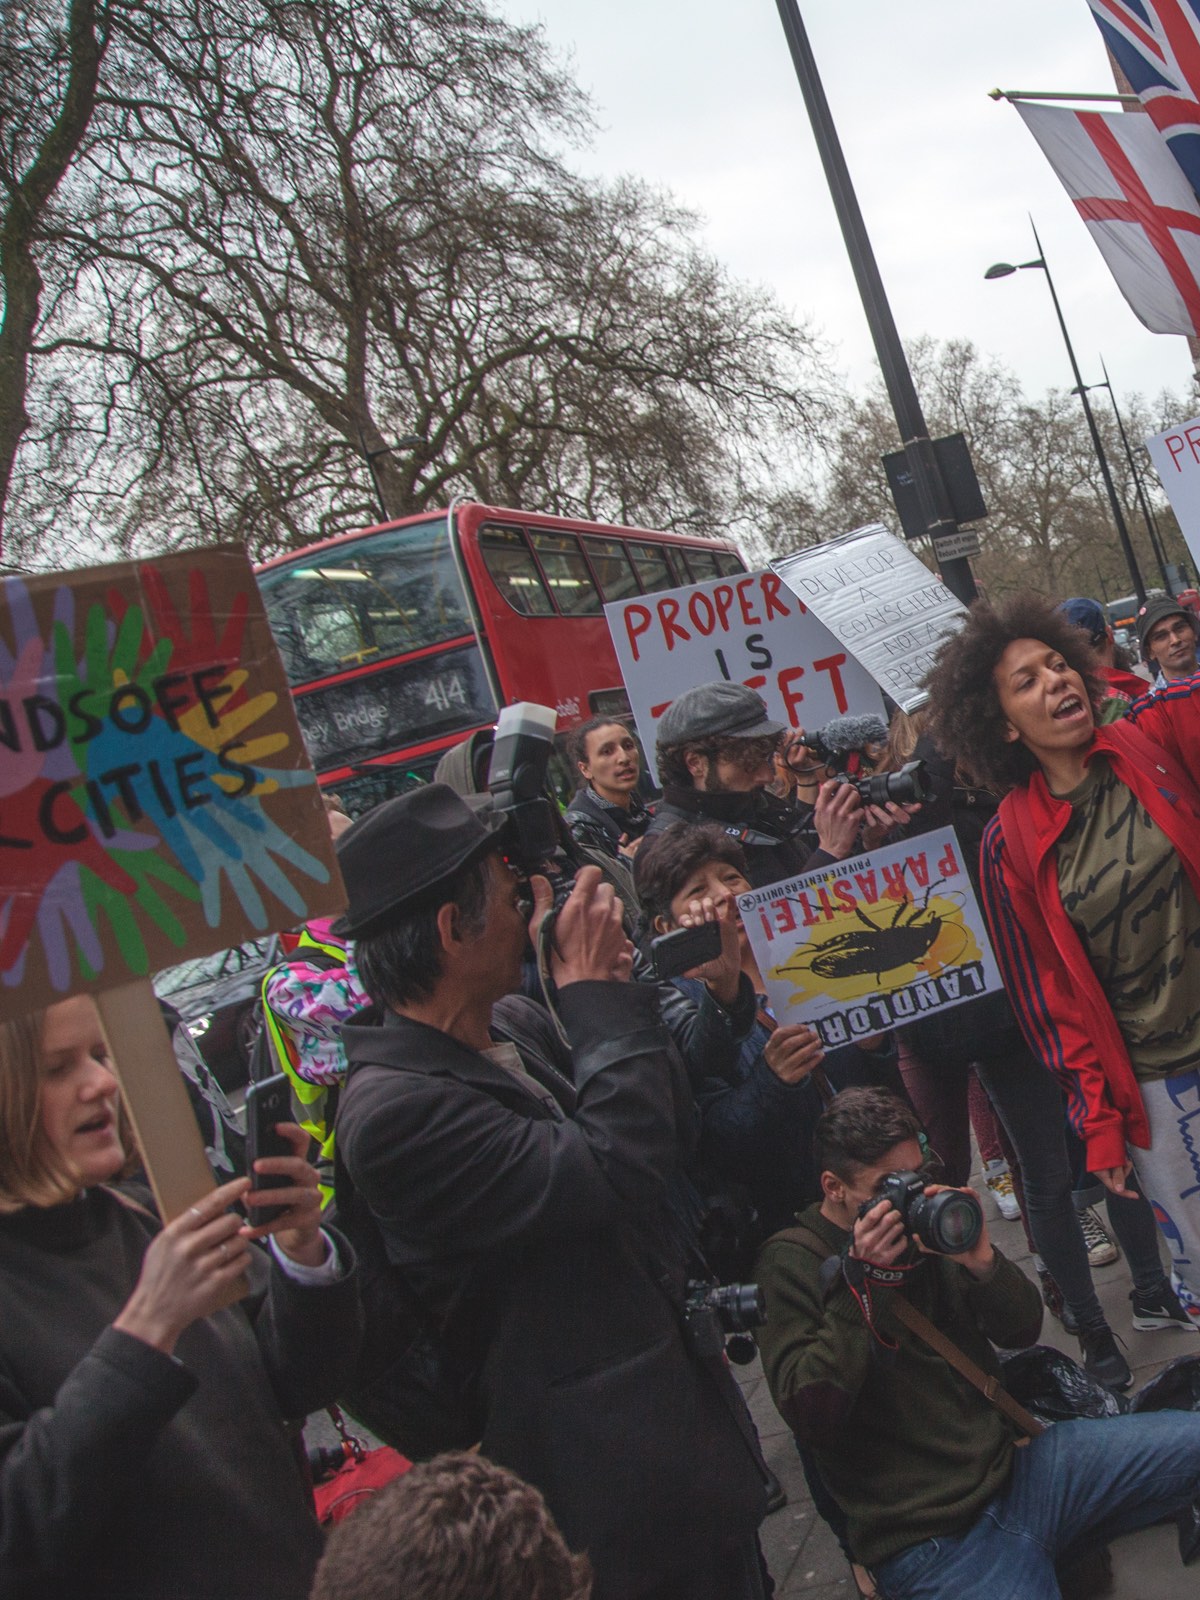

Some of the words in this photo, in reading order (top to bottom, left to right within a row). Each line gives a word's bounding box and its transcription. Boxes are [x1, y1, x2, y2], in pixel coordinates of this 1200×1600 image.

[800, 550, 895, 596] DEVELOP
[838, 584, 951, 639] CONSCIENCE
[858, 586, 881, 604] A
[623, 573, 807, 662] PROPER
[715, 633, 773, 681] IS
[882, 630, 922, 656] NOT
[425, 674, 467, 711] 414
[333, 705, 389, 731] Bridge
[39, 741, 256, 845] CITIES
[784, 872, 829, 895] RENTERS
[830, 858, 871, 883] PRIVATE
[755, 886, 785, 905] UNITE
[757, 843, 960, 941] PARASITE!
